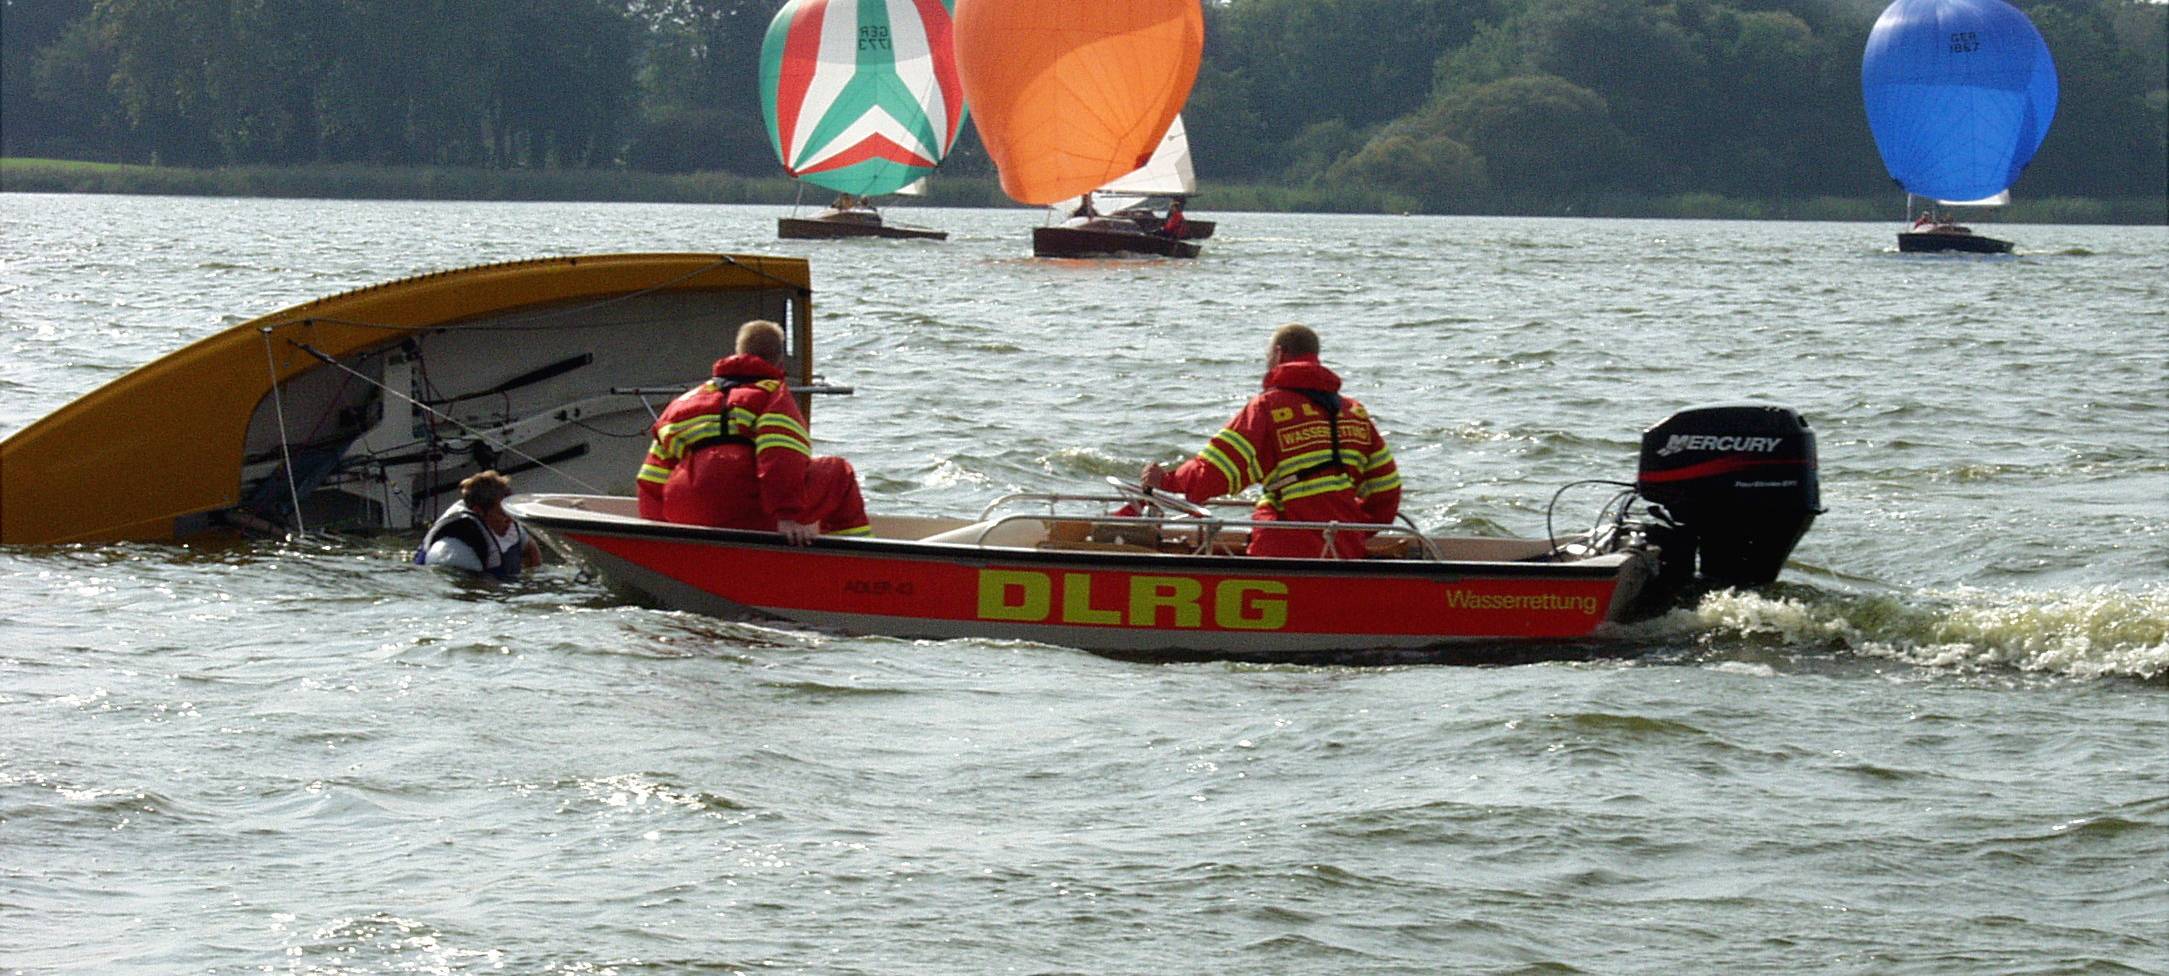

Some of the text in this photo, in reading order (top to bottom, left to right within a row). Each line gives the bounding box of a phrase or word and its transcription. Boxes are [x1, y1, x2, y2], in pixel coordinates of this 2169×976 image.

[1951, 31, 1976, 42] GER
[1271, 403, 1369, 423] DLG
[1659, 434, 1782, 455] MERCURY
[977, 568, 1288, 630] DLRG
[1446, 589, 1597, 615] Wasserrettung
